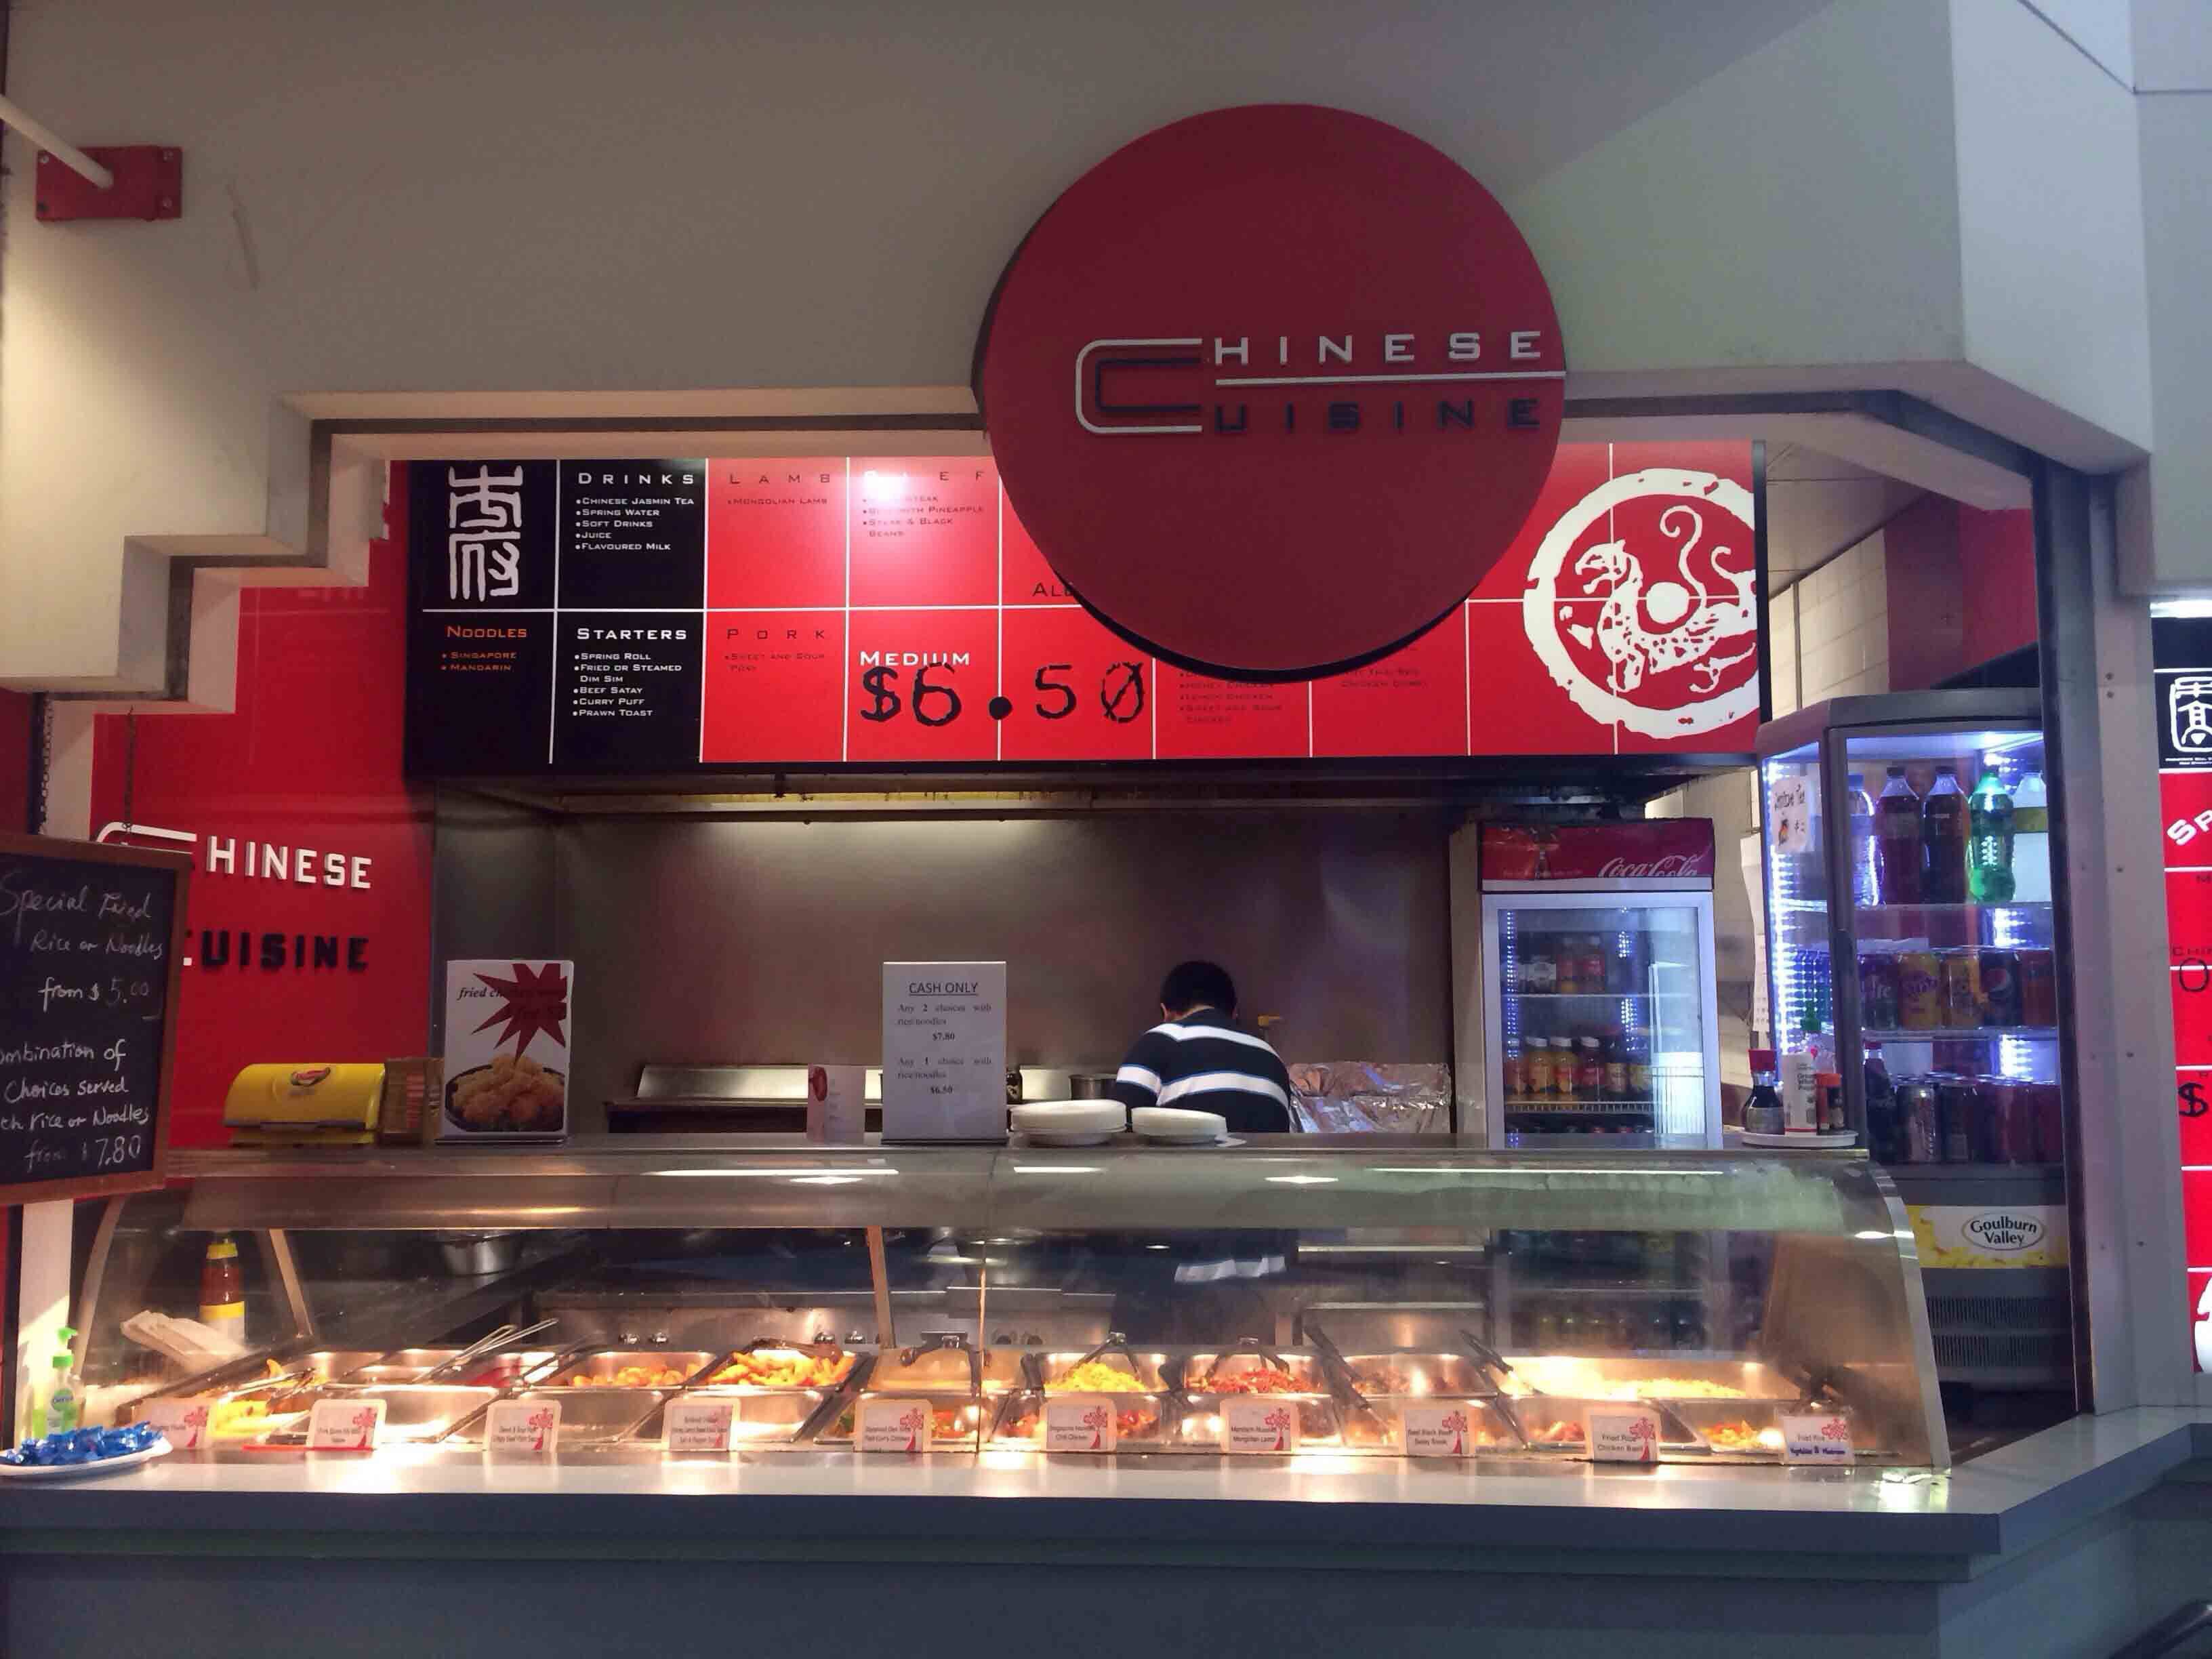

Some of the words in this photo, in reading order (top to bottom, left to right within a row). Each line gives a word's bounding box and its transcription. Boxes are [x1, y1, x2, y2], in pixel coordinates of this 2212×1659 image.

[578, 472, 695, 485] DRINKS
[729, 474, 830, 484] LAMB
[581, 497, 628, 505] CHINESE
[447, 626, 527, 638] NOODLES
[577, 628, 687, 640] STARTERS
[726, 629, 825, 640] PORK
[859, 651, 971, 667] MEDIUM
[79, 939, 98, 951] or
[183, 928, 369, 972] UISINE
[456, 987, 487, 1001] fried
[909, 982, 941, 994] CASH
[945, 982, 979, 994] ONLY
[38, 977, 83, 1012] from
[922, 1004, 928, 1012] 2
[104, 1038, 127, 1071] of
[68, 1118, 87, 1128] or
[1969, 1216, 2039, 1234] Goulburn
[1983, 1231, 2026, 1247] Valley
